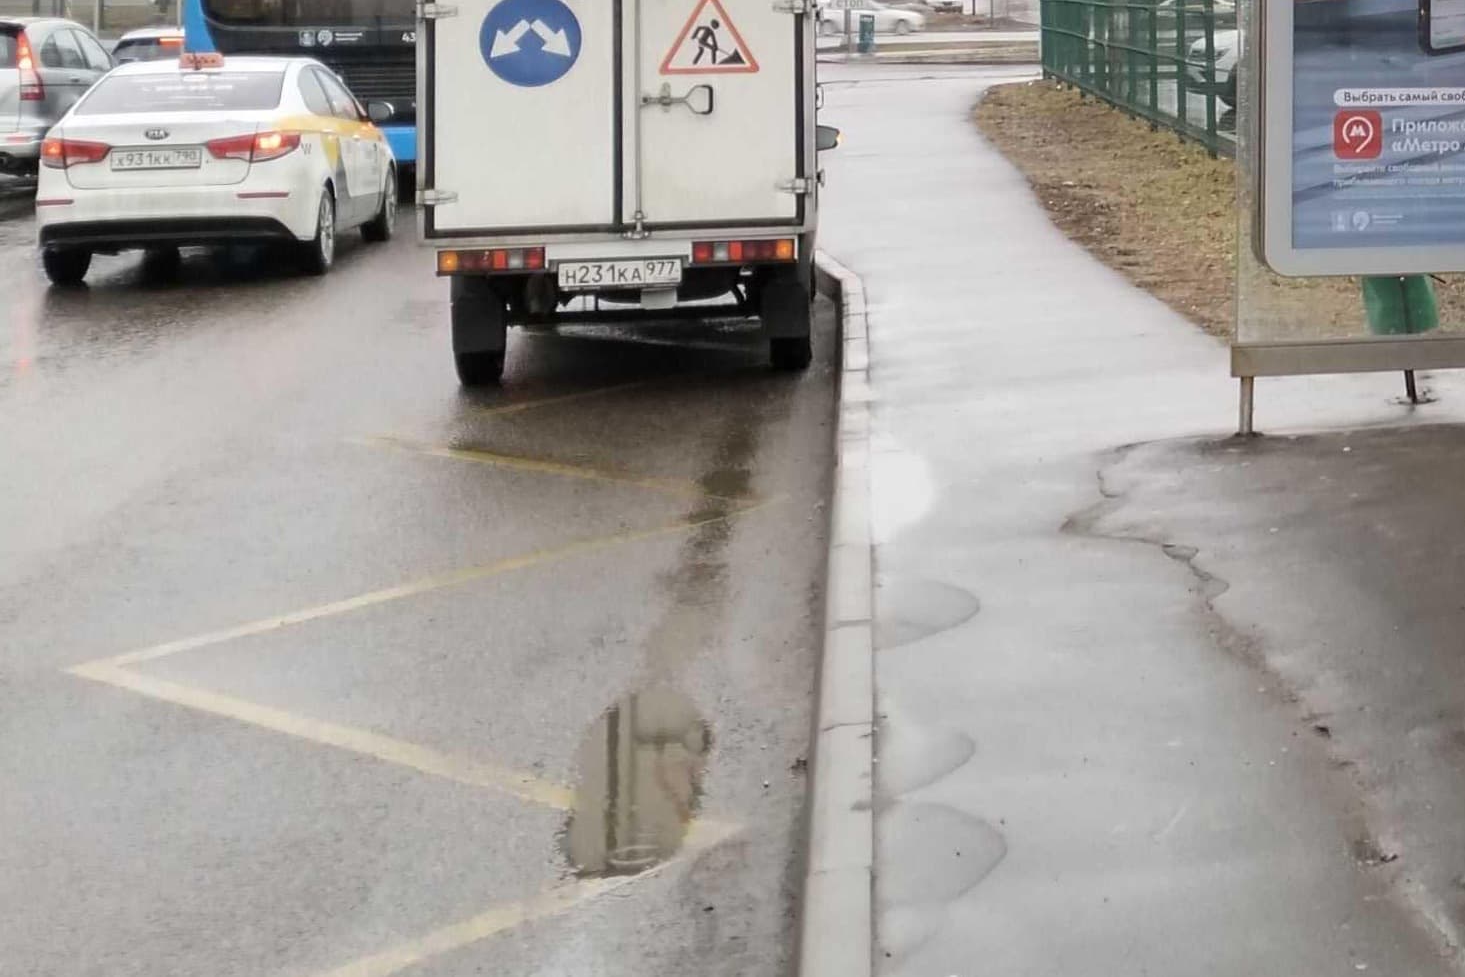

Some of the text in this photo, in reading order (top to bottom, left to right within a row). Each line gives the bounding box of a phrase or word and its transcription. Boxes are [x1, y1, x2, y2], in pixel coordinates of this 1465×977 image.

[1343, 91, 1397, 103] Выбрать
[1399, 90, 1439, 102] самый
[1391, 138, 1460, 155] «Метро
